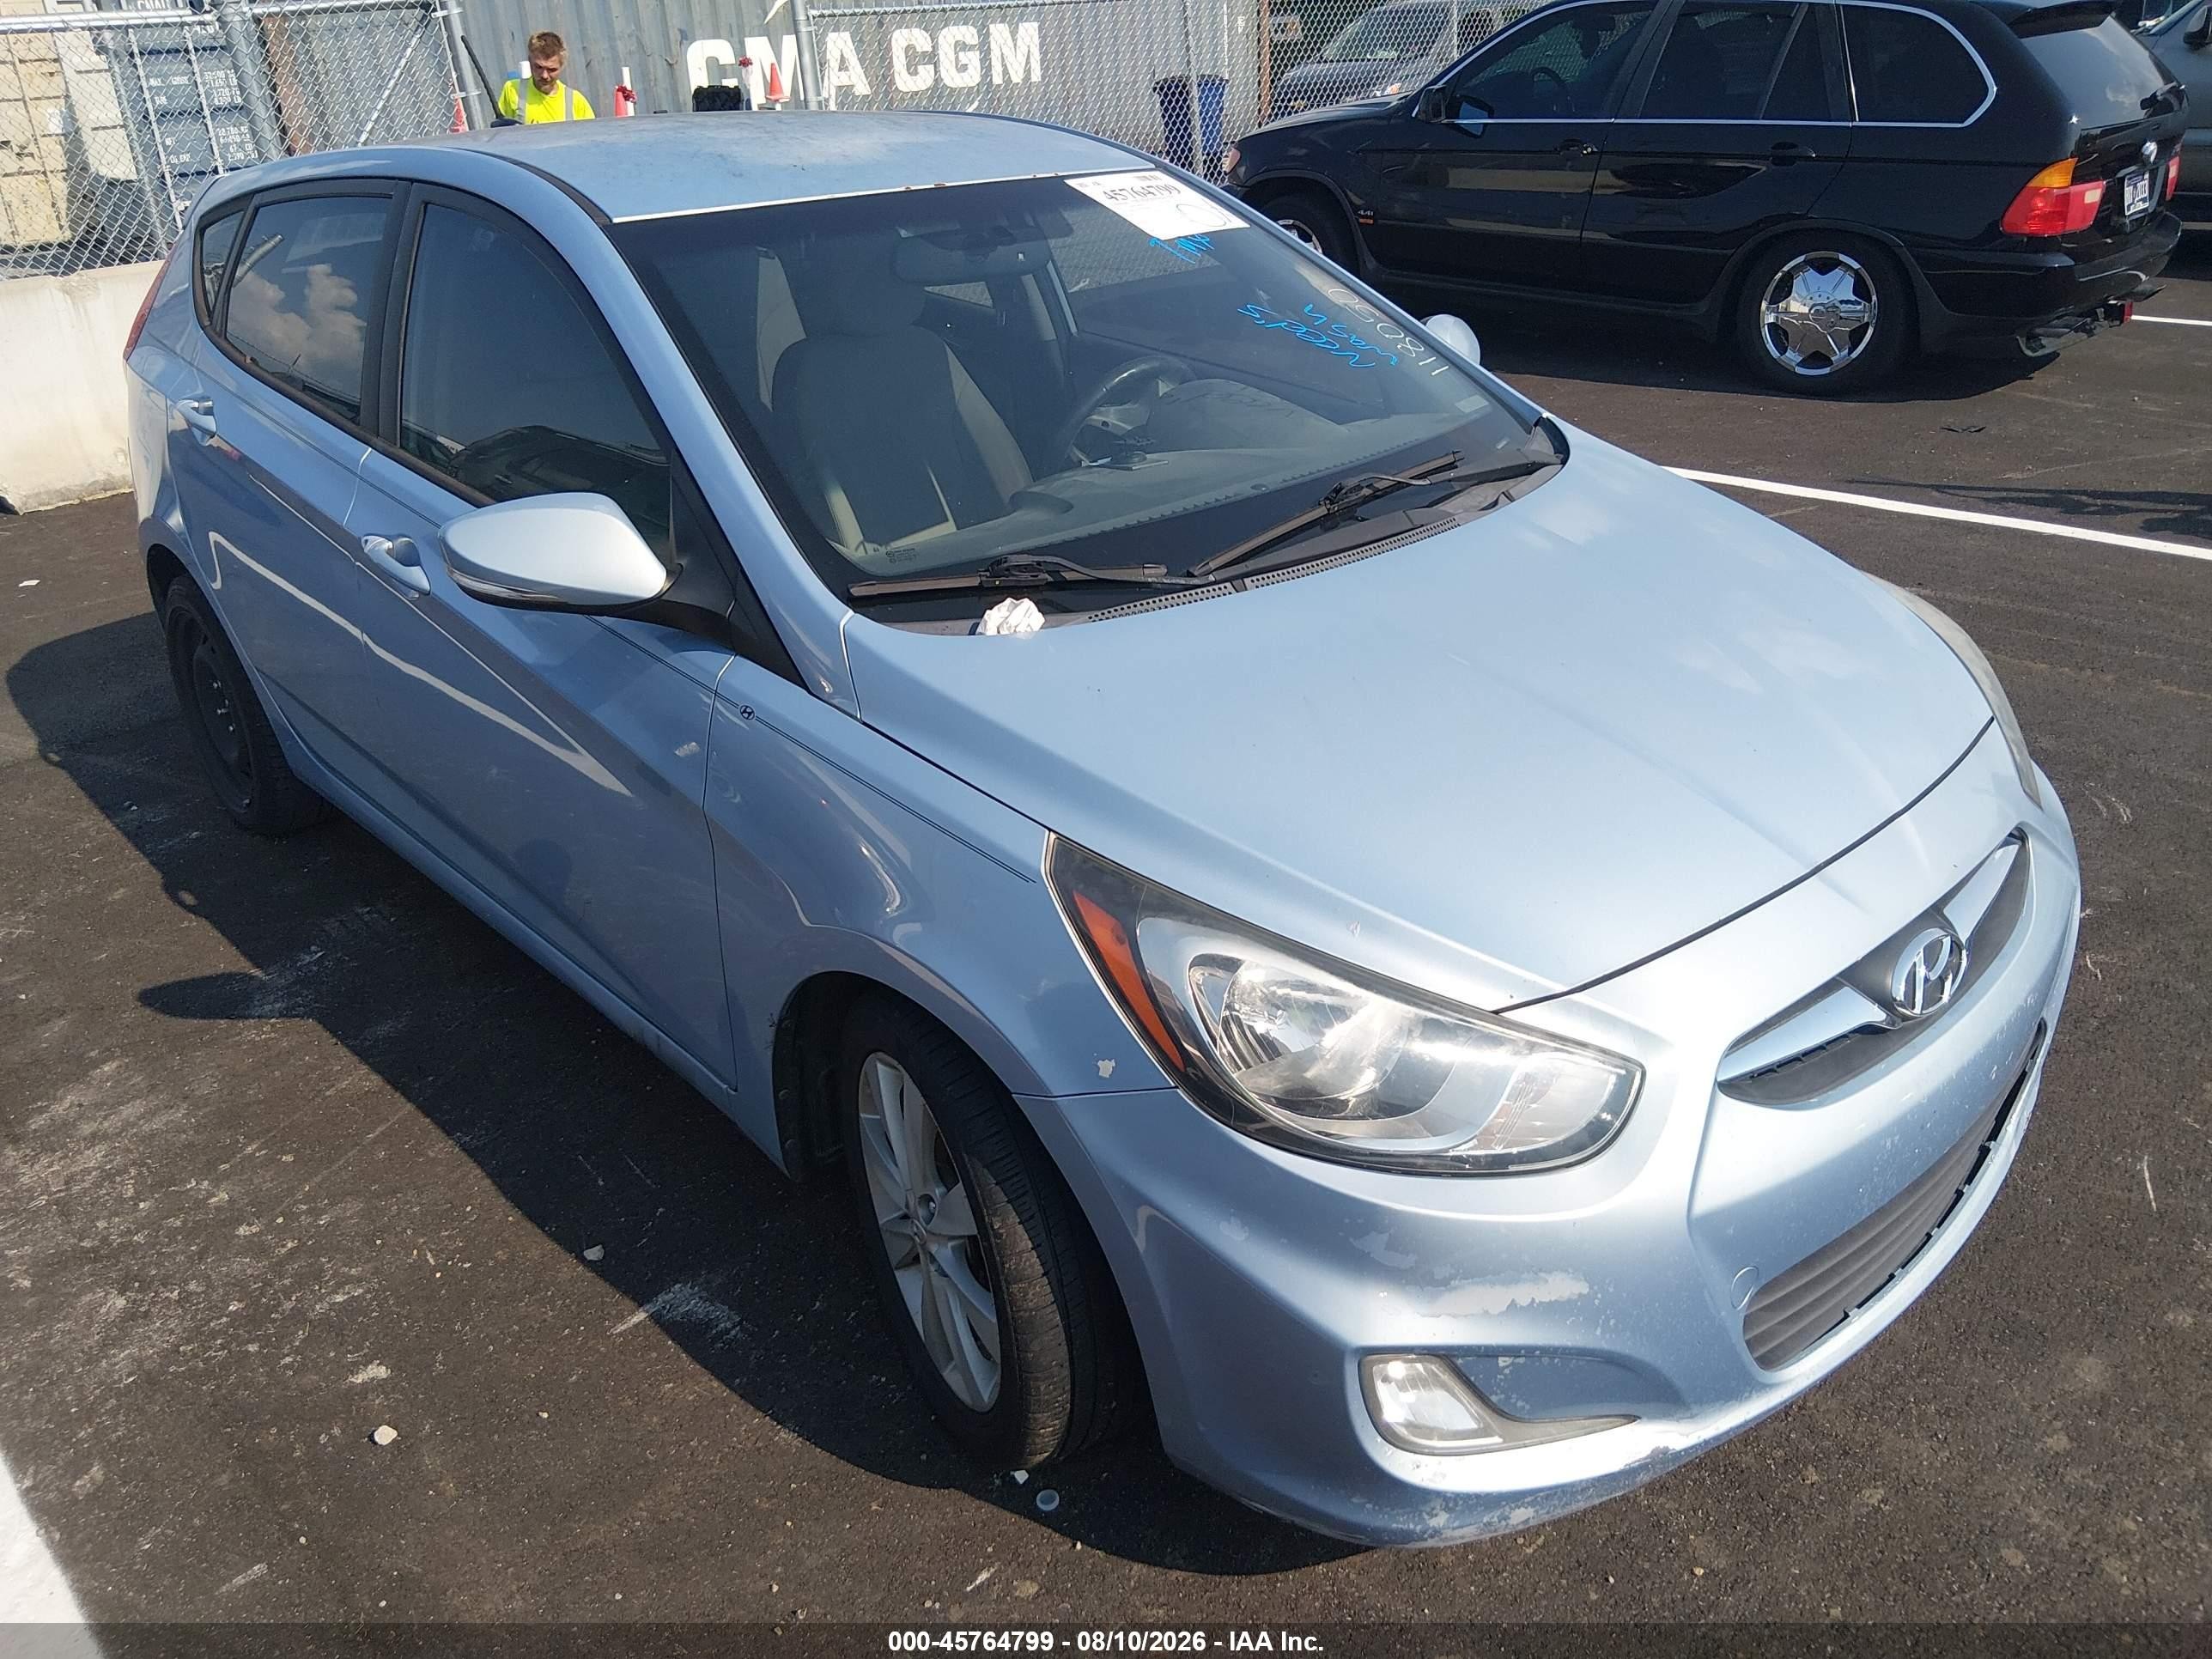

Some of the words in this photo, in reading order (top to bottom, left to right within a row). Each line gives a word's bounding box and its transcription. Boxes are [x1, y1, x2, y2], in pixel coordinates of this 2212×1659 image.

[687, 32, 871, 111] CMA
[891, 21, 1042, 93] CGM
[1102, 182, 1182, 202] 45764799
